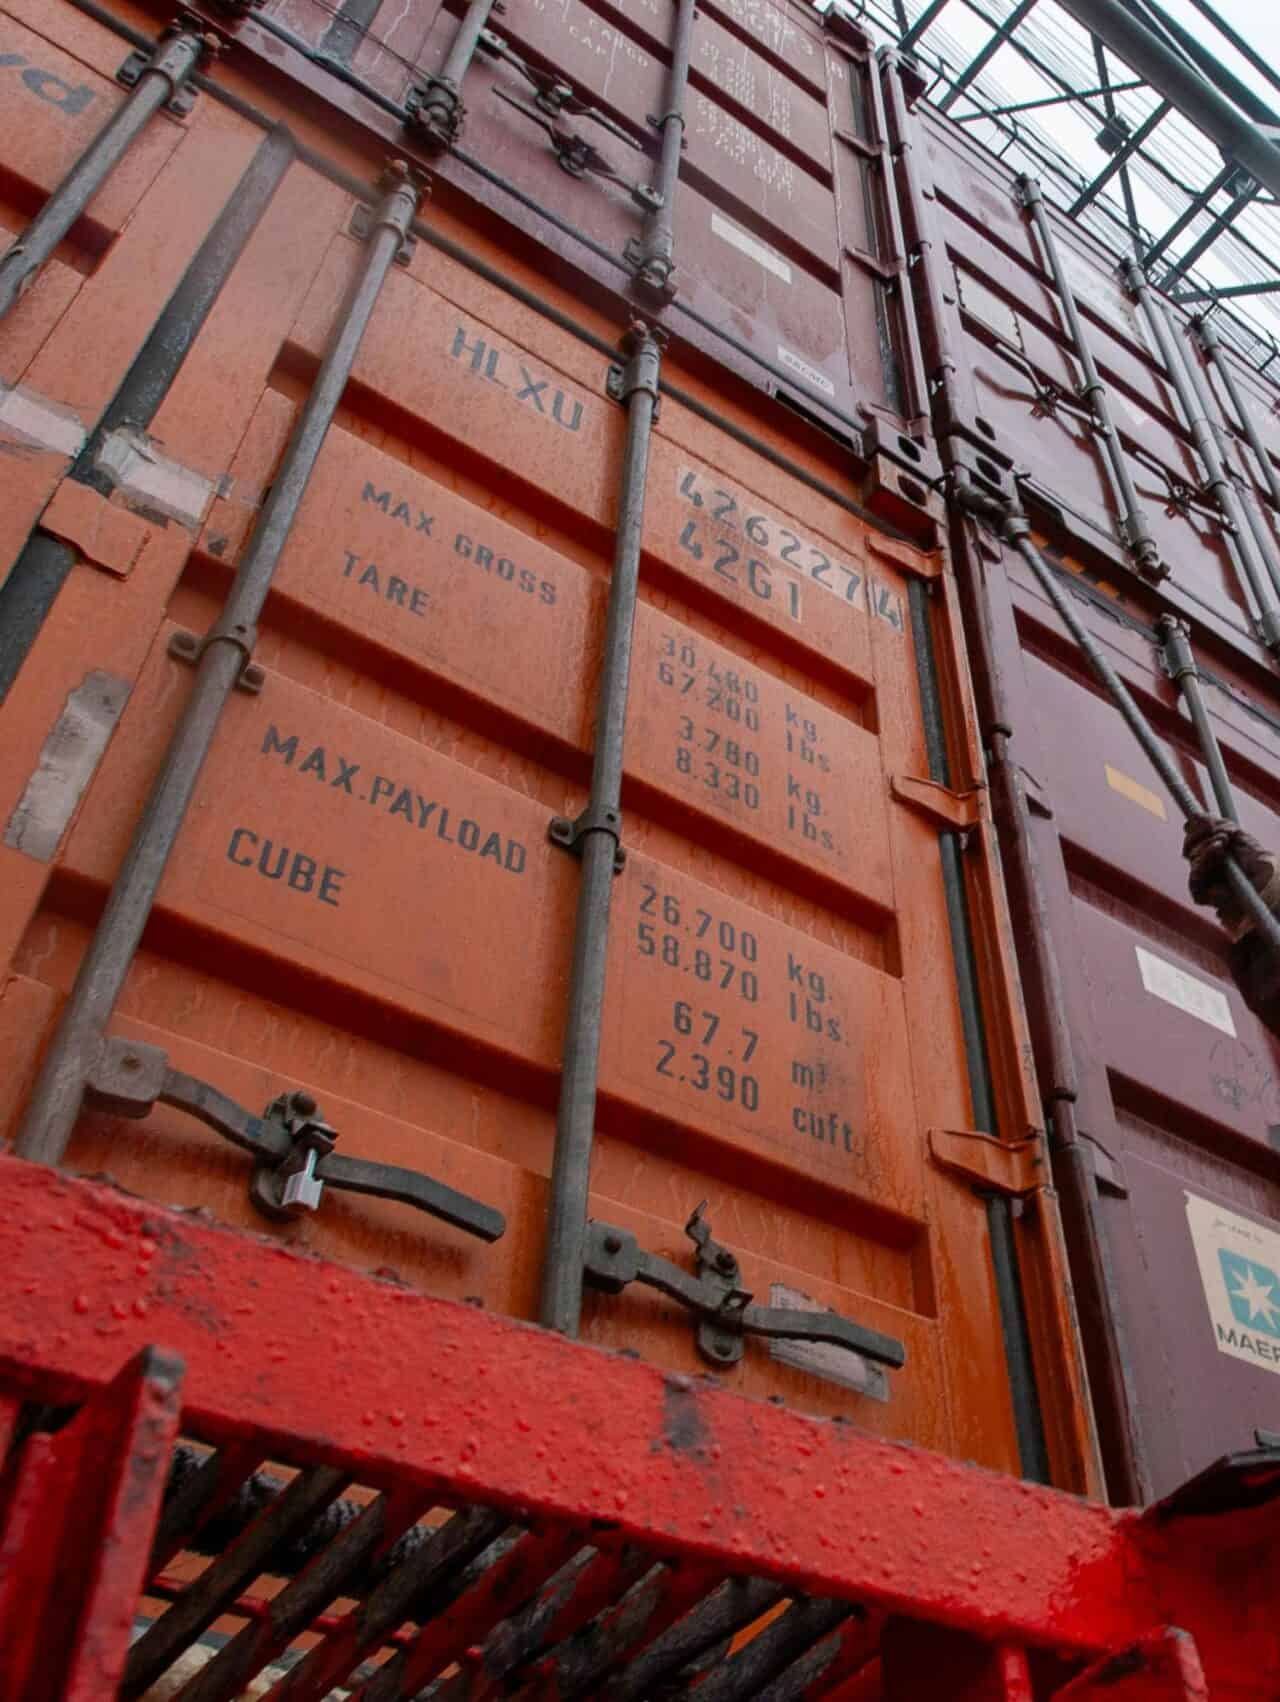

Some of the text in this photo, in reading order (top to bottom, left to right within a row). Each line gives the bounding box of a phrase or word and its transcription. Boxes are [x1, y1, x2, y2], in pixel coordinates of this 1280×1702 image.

[451, 327, 584, 432] HLXU
[679, 471, 862, 602] 426227
[361, 481, 436, 537] MAX
[453, 533, 557, 606] GROSS
[679, 521, 799, 619] 42G1
[341, 550, 431, 617] TARE
[678, 715, 760, 777] 3.780
[675, 747, 760, 809] 8.330
[225, 827, 348, 907] CUBE
[673, 1001, 759, 1063] 67.7
[637, 923, 759, 1003] 58.870
[639, 884, 758, 963] 26.700
[655, 1039, 760, 1112] 2.390
